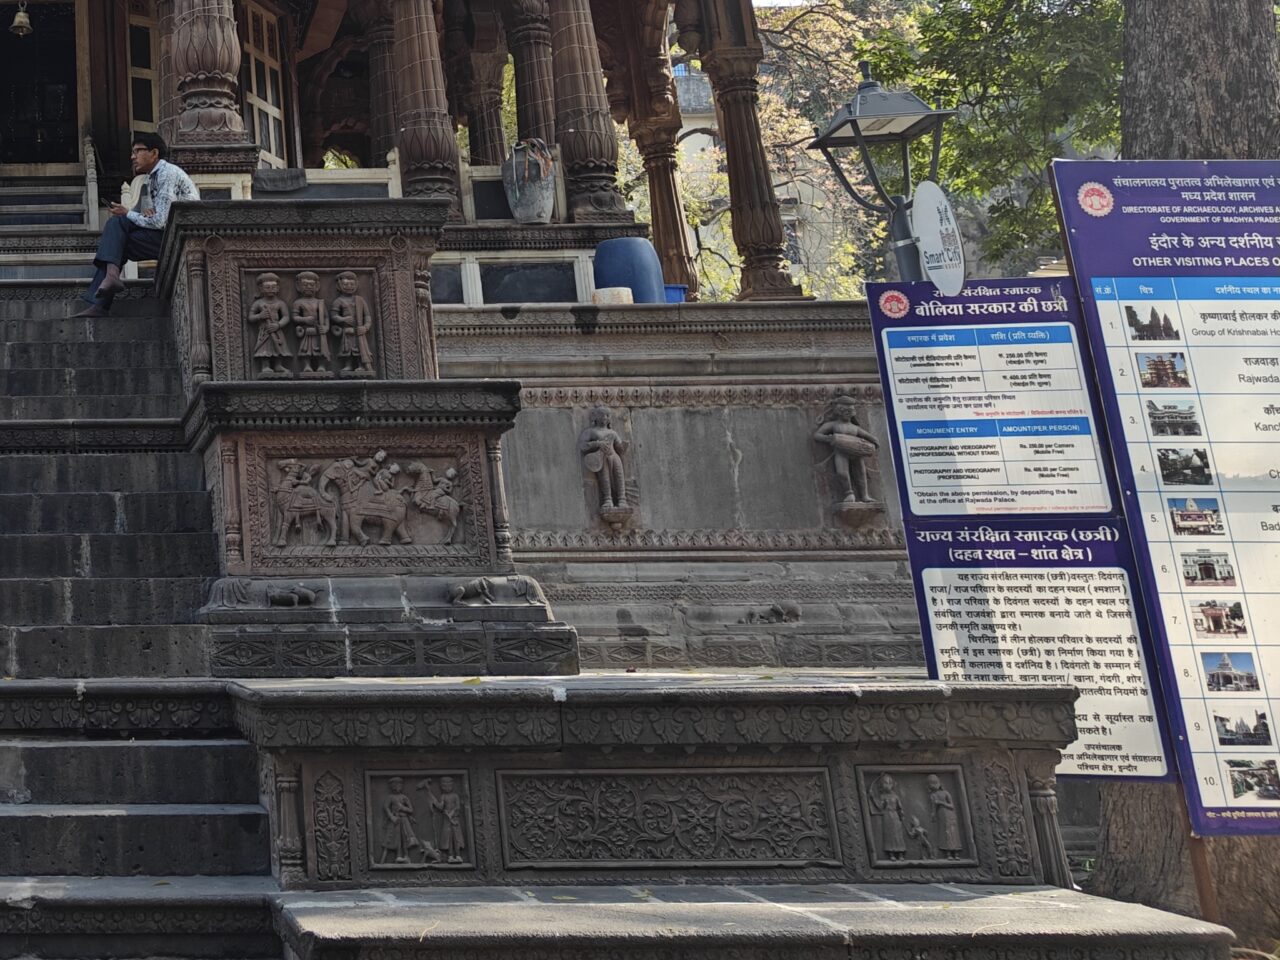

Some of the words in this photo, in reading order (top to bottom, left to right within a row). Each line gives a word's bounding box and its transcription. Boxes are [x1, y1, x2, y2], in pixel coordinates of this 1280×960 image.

[1181, 192, 1201, 201] मध्य
[1203, 189, 1226, 201] प्रदेश
[1228, 191, 1256, 201] शासन
[1183, 206, 1238, 214] ARCHAEOLOGY,
[1149, 232, 1178, 251] इंदौर
[1181, 232, 1194, 248] के
[1198, 236, 1226, 249] अन्य
[1228, 232, 1273, 249] दर्शनीय
[923, 250, 945, 265] Smart
[945, 246, 962, 263] City
[1132, 257, 1171, 266] OTHER
[1173, 257, 1222, 266] VISITING
[1225, 257, 1270, 266] PLACES
[961, 285, 1001, 297] संरक्षित
[1003, 286, 1042, 295] स्मारक
[914, 300, 963, 316] बोलिया
[966, 301, 1017, 315] सरकार
[1018, 297, 1039, 313] की
[1040, 296, 1069, 312] छत्री
[1200, 311, 1237, 325] कृष्णाबाई
[1239, 310, 1269, 322] होलकर
[1191, 328, 1216, 337] Group
[1217, 327, 1226, 336] of
[1227, 327, 1269, 336] Krishnabai
[971, 489, 1010, 498] permission,
[1150, 515, 1160, 523] 5.
[915, 529, 952, 542] राज्य
[956, 527, 1011, 543] संरक्षित
[1014, 529, 1069, 542] स्मारक
[1071, 526, 1120, 542] (छत्री)
[948, 547, 983, 562] (दहन
[985, 548, 1016, 560] स्थल
[1031, 545, 1058, 560] शांत
[1060, 545, 1085, 560] क्षेत्र
[1161, 565, 1170, 574] 6.
[957, 573, 970, 581] यह
[970, 573, 989, 581] राज्य
[990, 571, 1018, 581] संरक्षित
[1019, 573, 1045, 581] स्मारक
[1098, 571, 1125, 581] दिवंगत
[970, 584, 996, 594] परिवार
[996, 584, 1005, 593] के
[1047, 586, 1065, 594] दहन
[963, 596, 990, 605] परिवार
[993, 596, 1001, 605] के
[1003, 596, 1030, 605] दिवंगत
[1064, 597, 1073, 605] के
[1076, 598, 1093, 606] दहन
[1096, 598, 1116, 606] स्थल
[1119, 598, 1130, 606] पर
[1074, 609, 1092, 618] जाते
[1106, 609, 1132, 618] जिससे
[1172, 616, 1181, 625] 7.
[935, 621, 959, 631] उनकी
[959, 621, 980, 633] स्मृति
[1009, 634, 1026, 643] लीन
[1027, 634, 1056, 643] होलकर
[1057, 634, 1084, 644] परिवार
[1085, 634, 1094, 643] के
[1126, 634, 1138, 644] की
[939, 646, 960, 658] स्मृति
[972, 648, 985, 657] इस
[987, 648, 1013, 656] स्मारक
[1016, 646, 1041, 658] (छत्री)
[1058, 646, 1084, 656] निर्माण
[1086, 647, 1106, 656] किया
[1109, 649, 1125, 657] गया
[1127, 648, 1134, 657] है
[968, 661, 1003, 669] कलात्मक
[1045, 660, 1052, 670] है
[1092, 661, 1101, 670] के
[1104, 662, 1132, 670] सम्मान
[974, 673, 990, 681] नशा
[1183, 668, 1192, 678] 8.
[1139, 686, 1148, 696] के
[1092, 712, 1101, 722] से
[1138, 715, 1154, 723] तक
[1194, 722, 1204, 731] 9.
[1084, 742, 1122, 751] उपसंचालक
[1204, 776, 1218, 786] 10.
